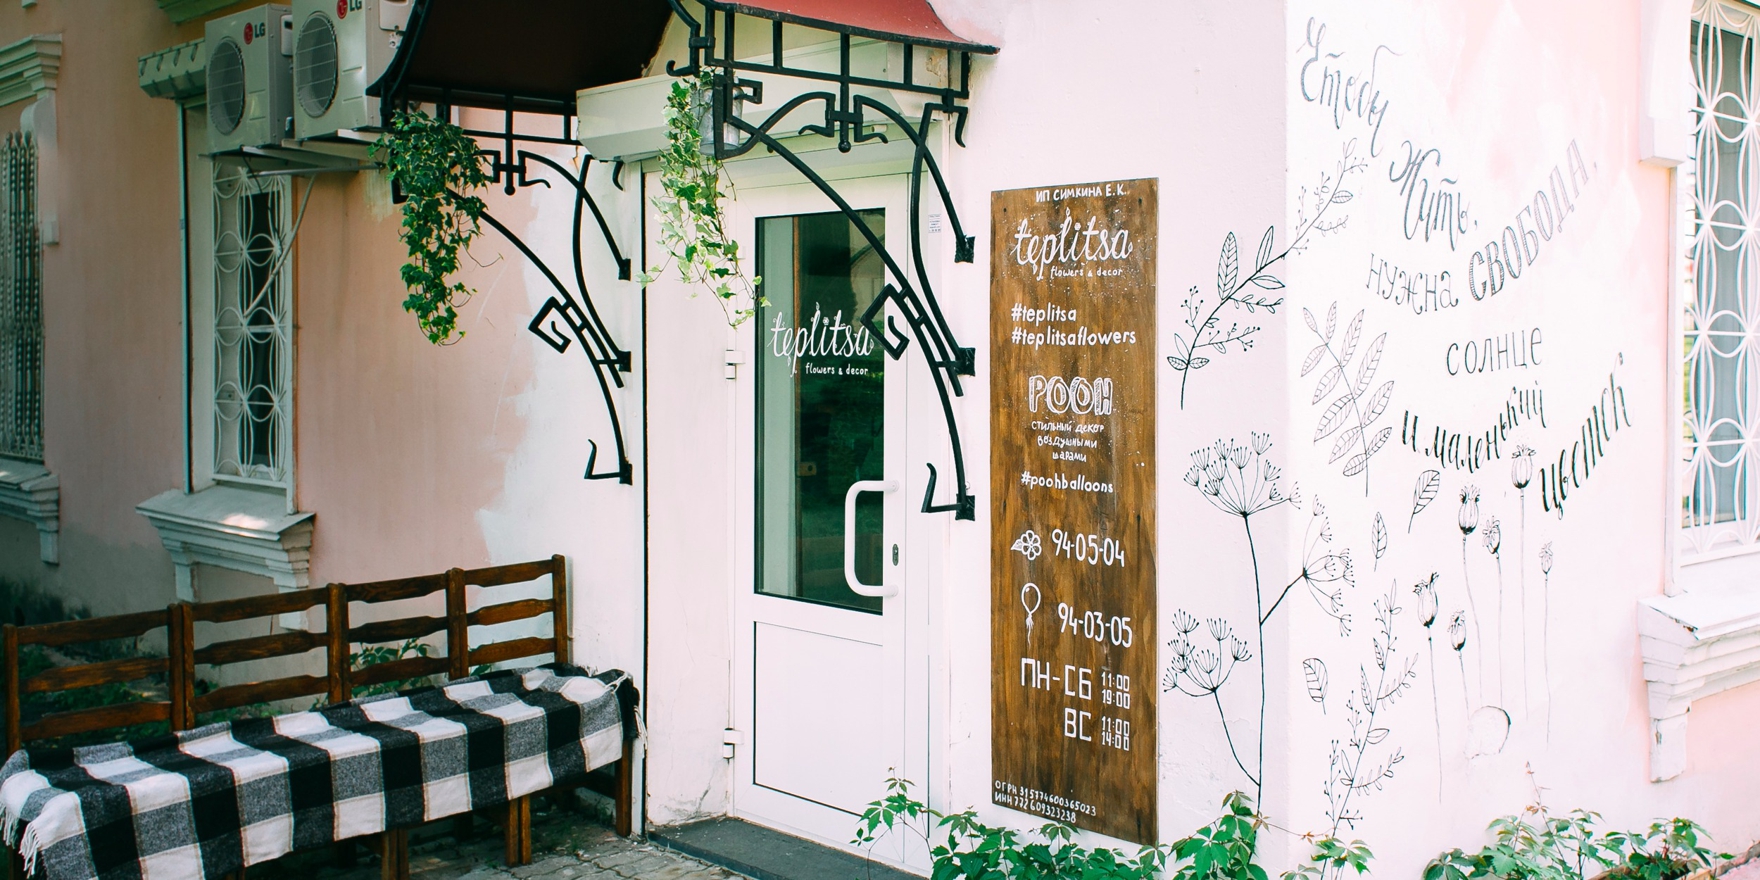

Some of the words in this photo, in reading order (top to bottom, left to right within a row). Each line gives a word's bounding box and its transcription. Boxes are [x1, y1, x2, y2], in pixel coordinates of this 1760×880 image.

[349, 0, 363, 11] LG
[254, 22, 266, 38] LG
[1035, 189, 1050, 202] ИП
[1053, 185, 1102, 199] СИМКИНА
[1010, 207, 1133, 281] teplitsa
[1050, 266, 1084, 279] flowers
[1096, 267, 1123, 277] decor
[1366, 253, 1459, 315] нужна
[1011, 302, 1077, 326] #teplitsa
[767, 302, 874, 378] teplitsa
[1011, 326, 1136, 350] #teplitsaflowers
[1446, 327, 1542, 376] солнце
[805, 362, 835, 375] flowers
[838, 367, 843, 375] &
[845, 363, 869, 375] decor
[1028, 375, 1113, 416] POOH
[1424, 380, 1547, 473] маленький
[1021, 470, 1113, 493] #poohballoons
[1052, 528, 1125, 567] 94-05-04
[1058, 602, 1132, 648] 94-03-05
[1101, 671, 1130, 692] 11:00
[1101, 689, 1131, 710] 19:00
[1064, 707, 1092, 742] ВС
[1101, 716, 1130, 737] 11:00
[1101, 731, 1130, 751] 14:00
[995, 780, 1017, 795] ОГРН
[995, 791, 1013, 805] ИНН
